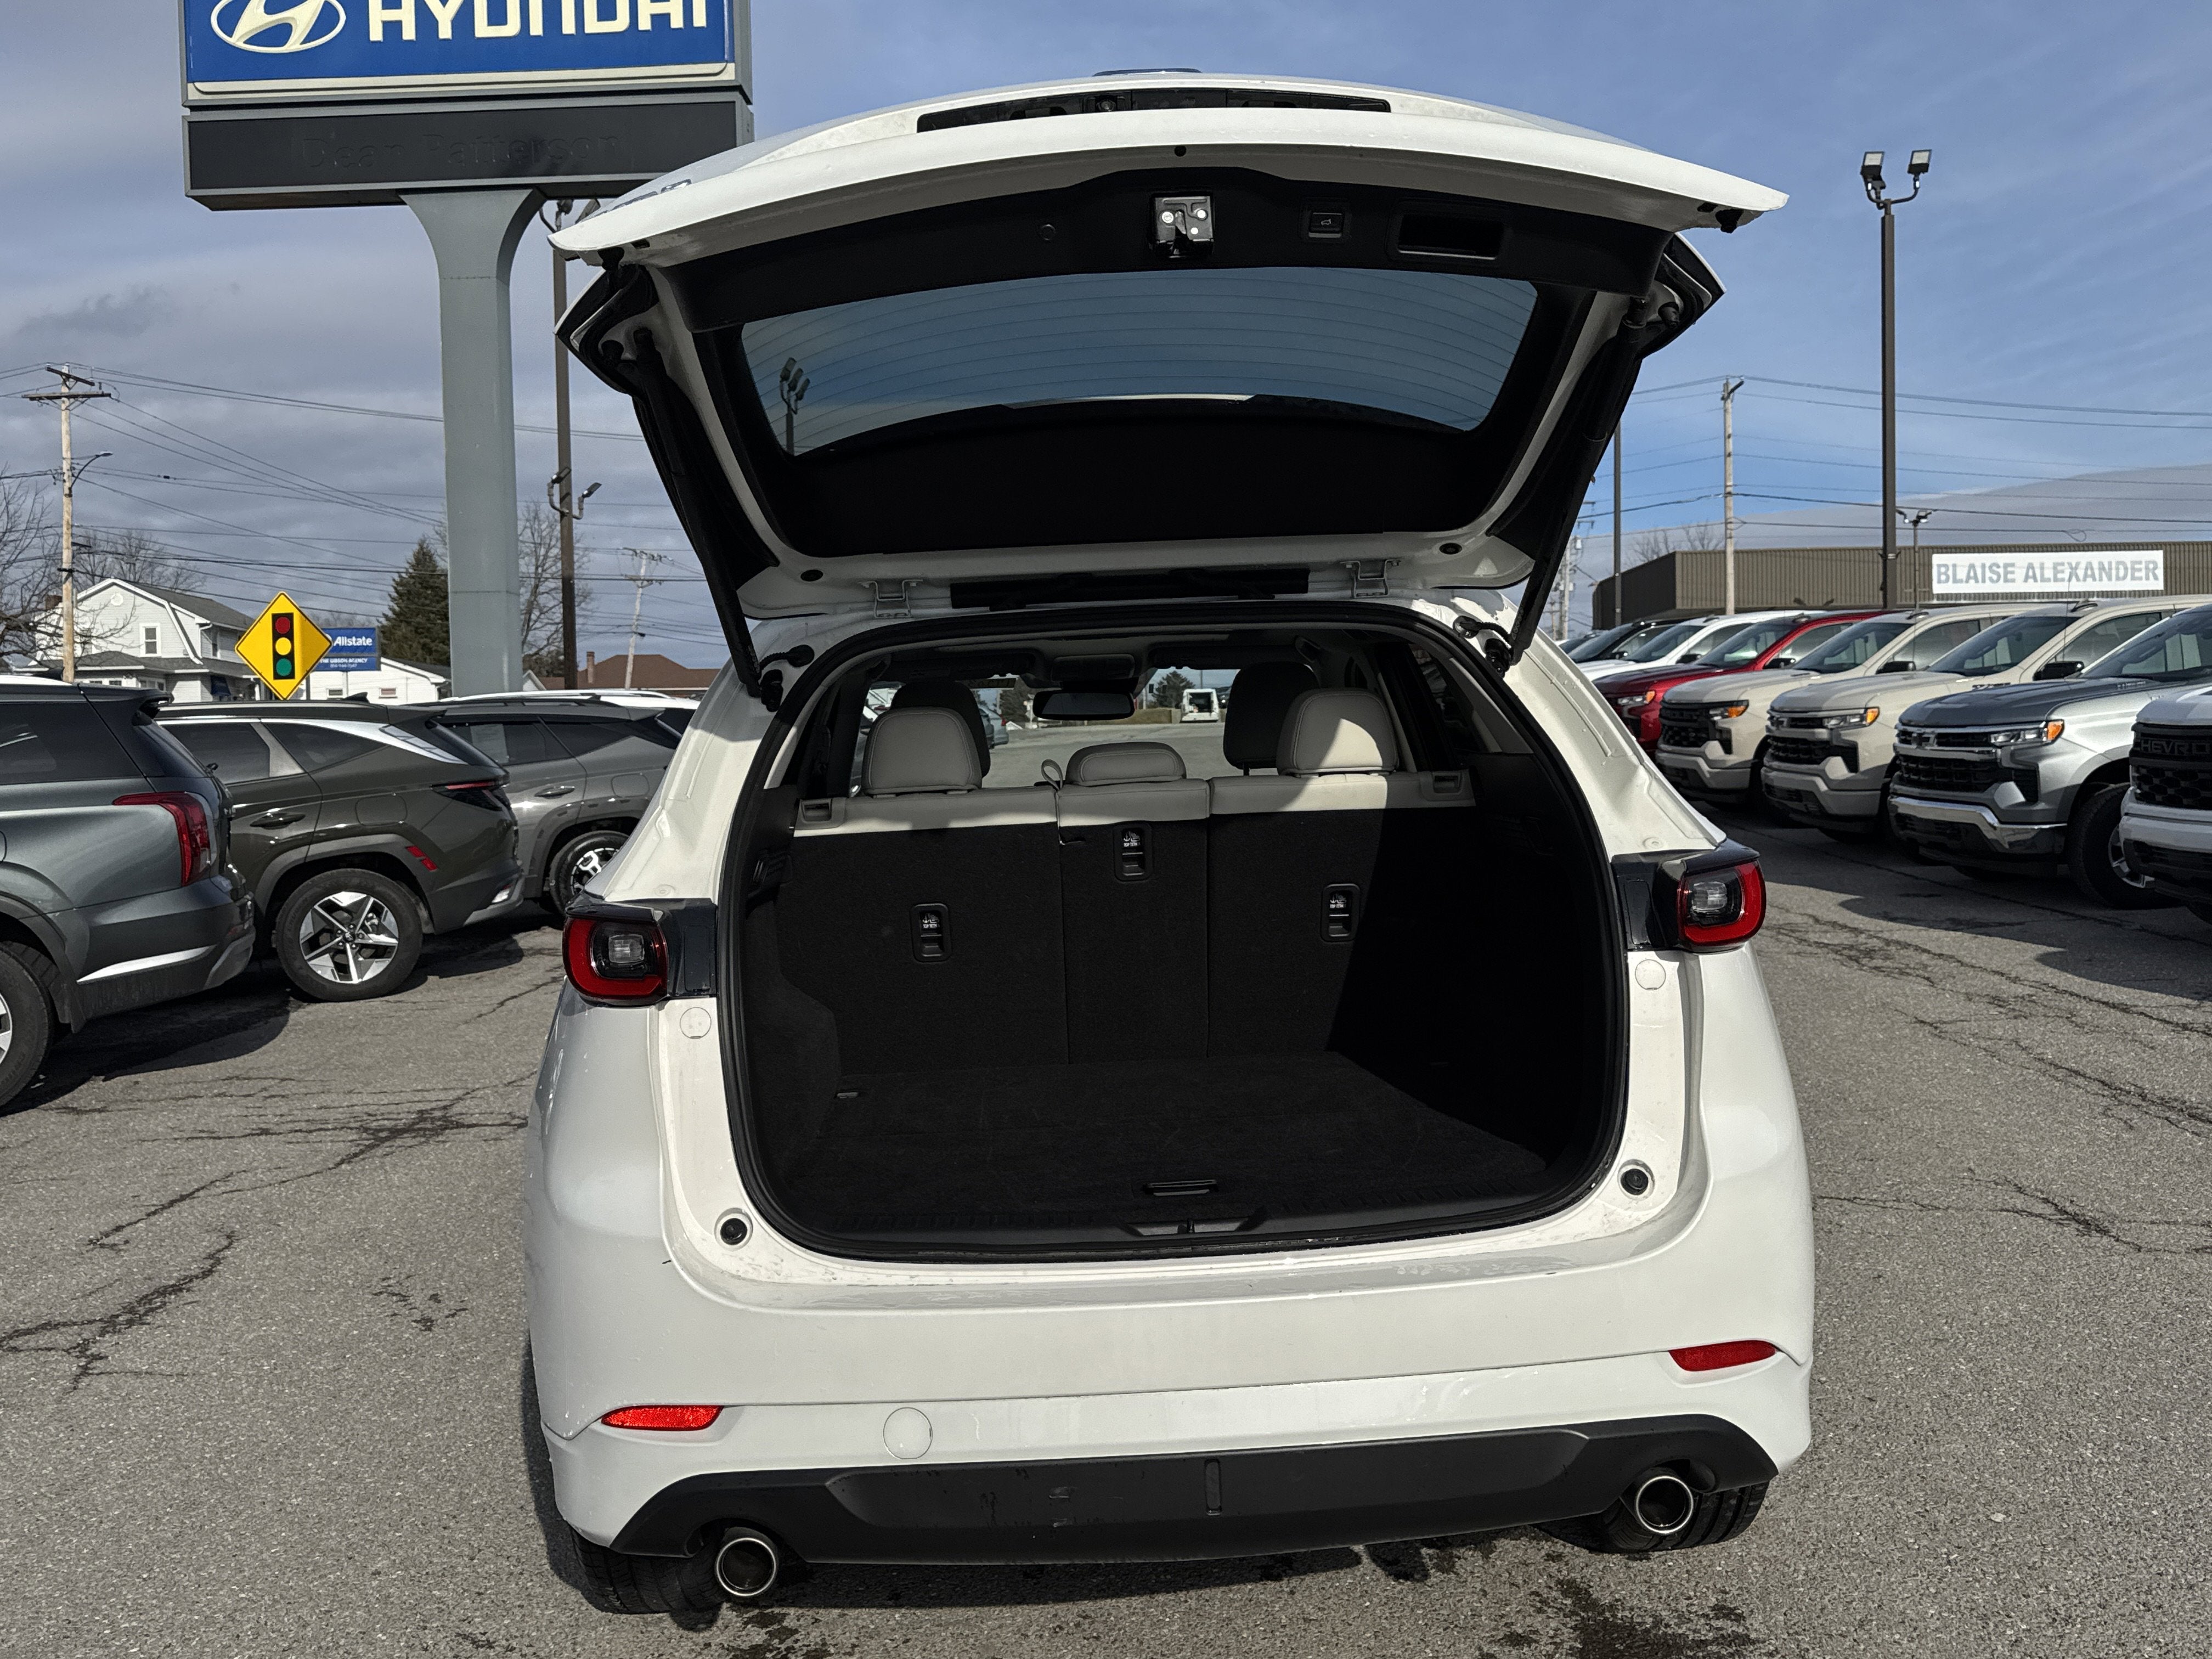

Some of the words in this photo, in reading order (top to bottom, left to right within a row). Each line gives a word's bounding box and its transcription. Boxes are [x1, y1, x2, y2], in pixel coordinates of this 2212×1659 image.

[369, 0, 708, 42] HYUNDAI
[423, 133, 624, 167] Patterson
[1936, 562, 2016, 584] BLAISE
[2023, 560, 2159, 583] ALEXANDER
[334, 636, 373, 646] Allstate
